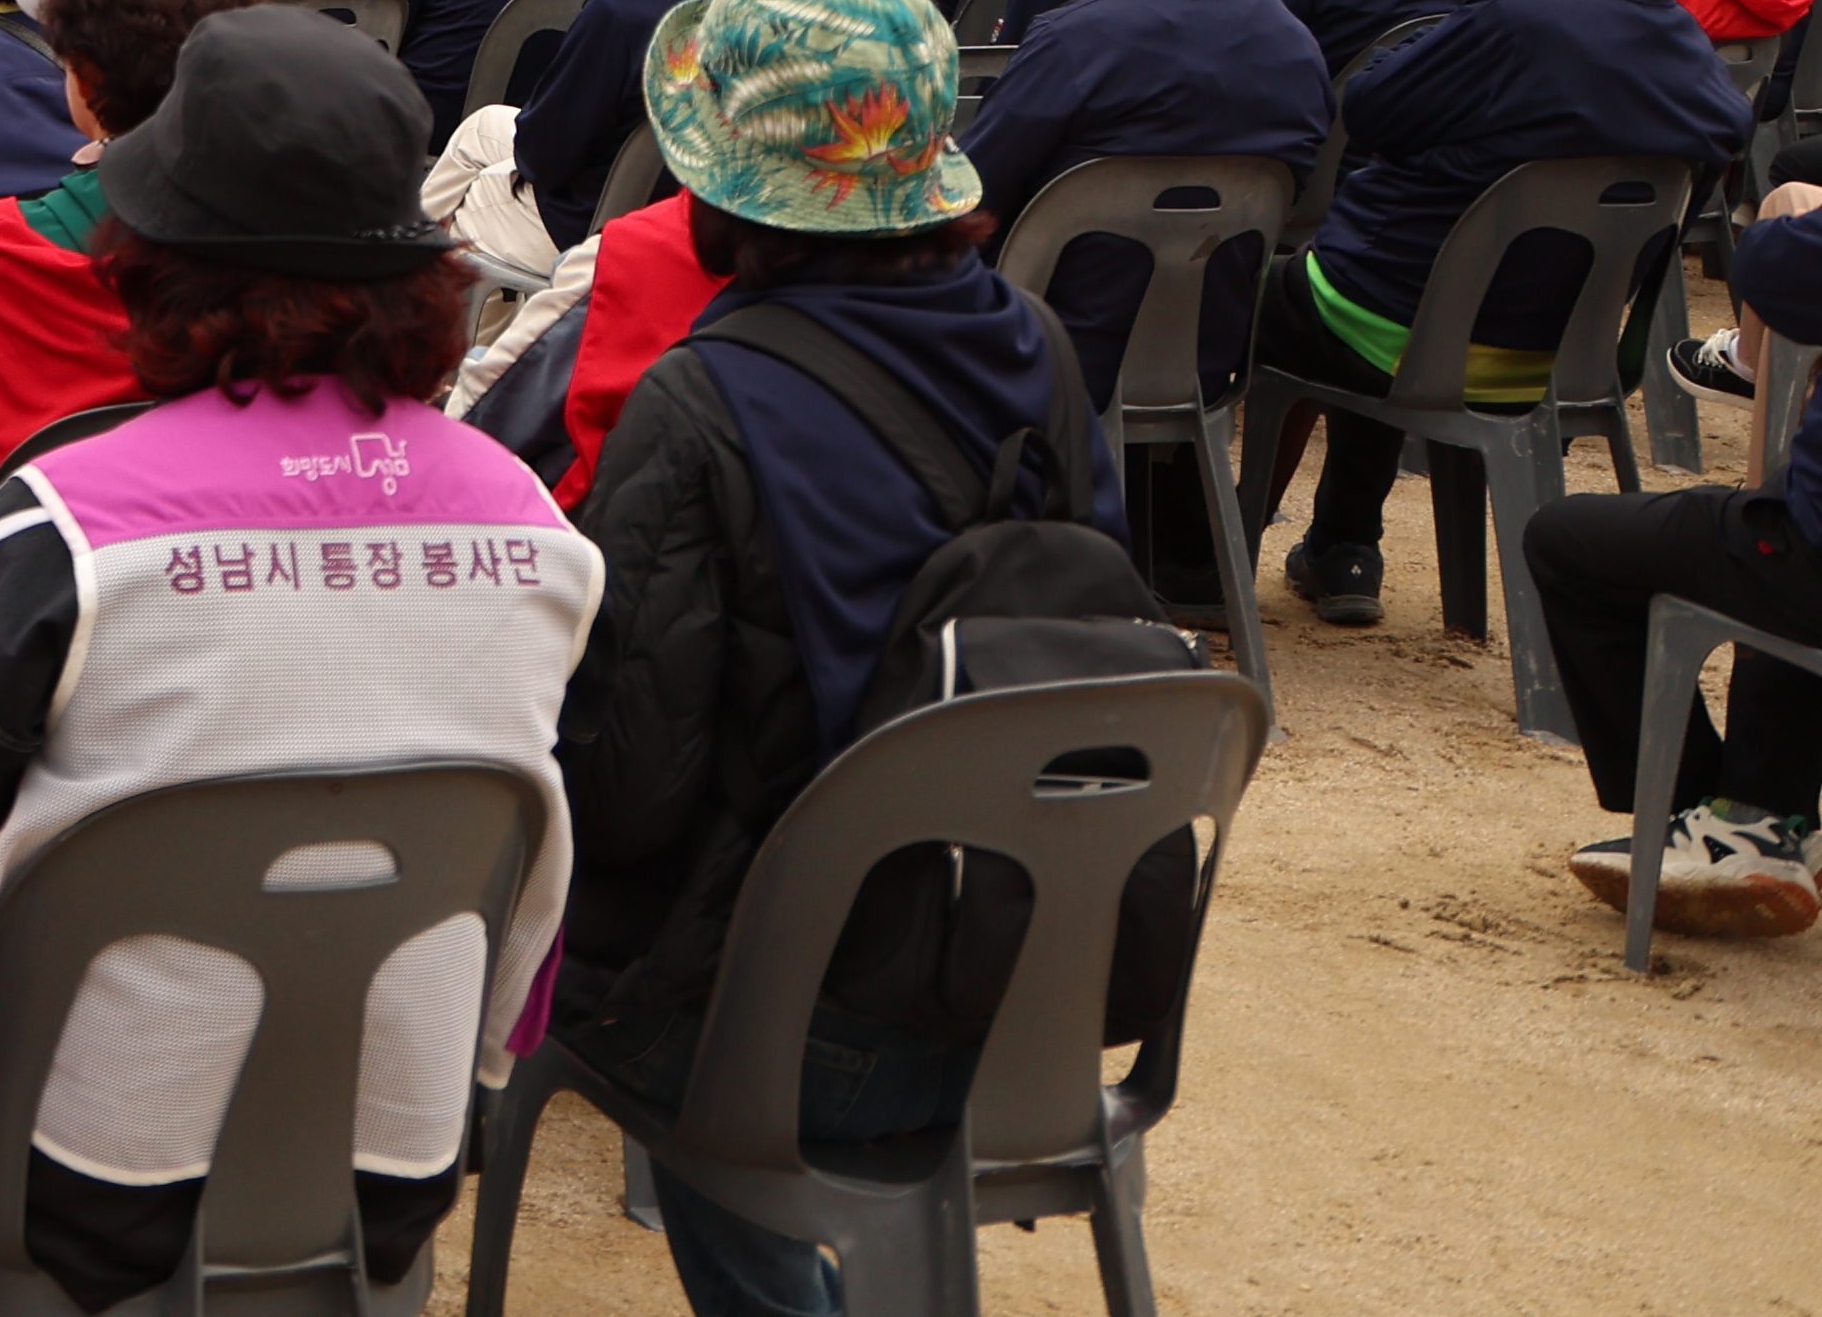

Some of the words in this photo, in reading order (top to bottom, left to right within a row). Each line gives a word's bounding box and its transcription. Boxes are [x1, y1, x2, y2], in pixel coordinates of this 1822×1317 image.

[279, 455, 352, 482] 희망도시
[165, 542, 301, 593] 성남시
[320, 542, 403, 591] 통장
[422, 538, 540, 588] 봉사단
